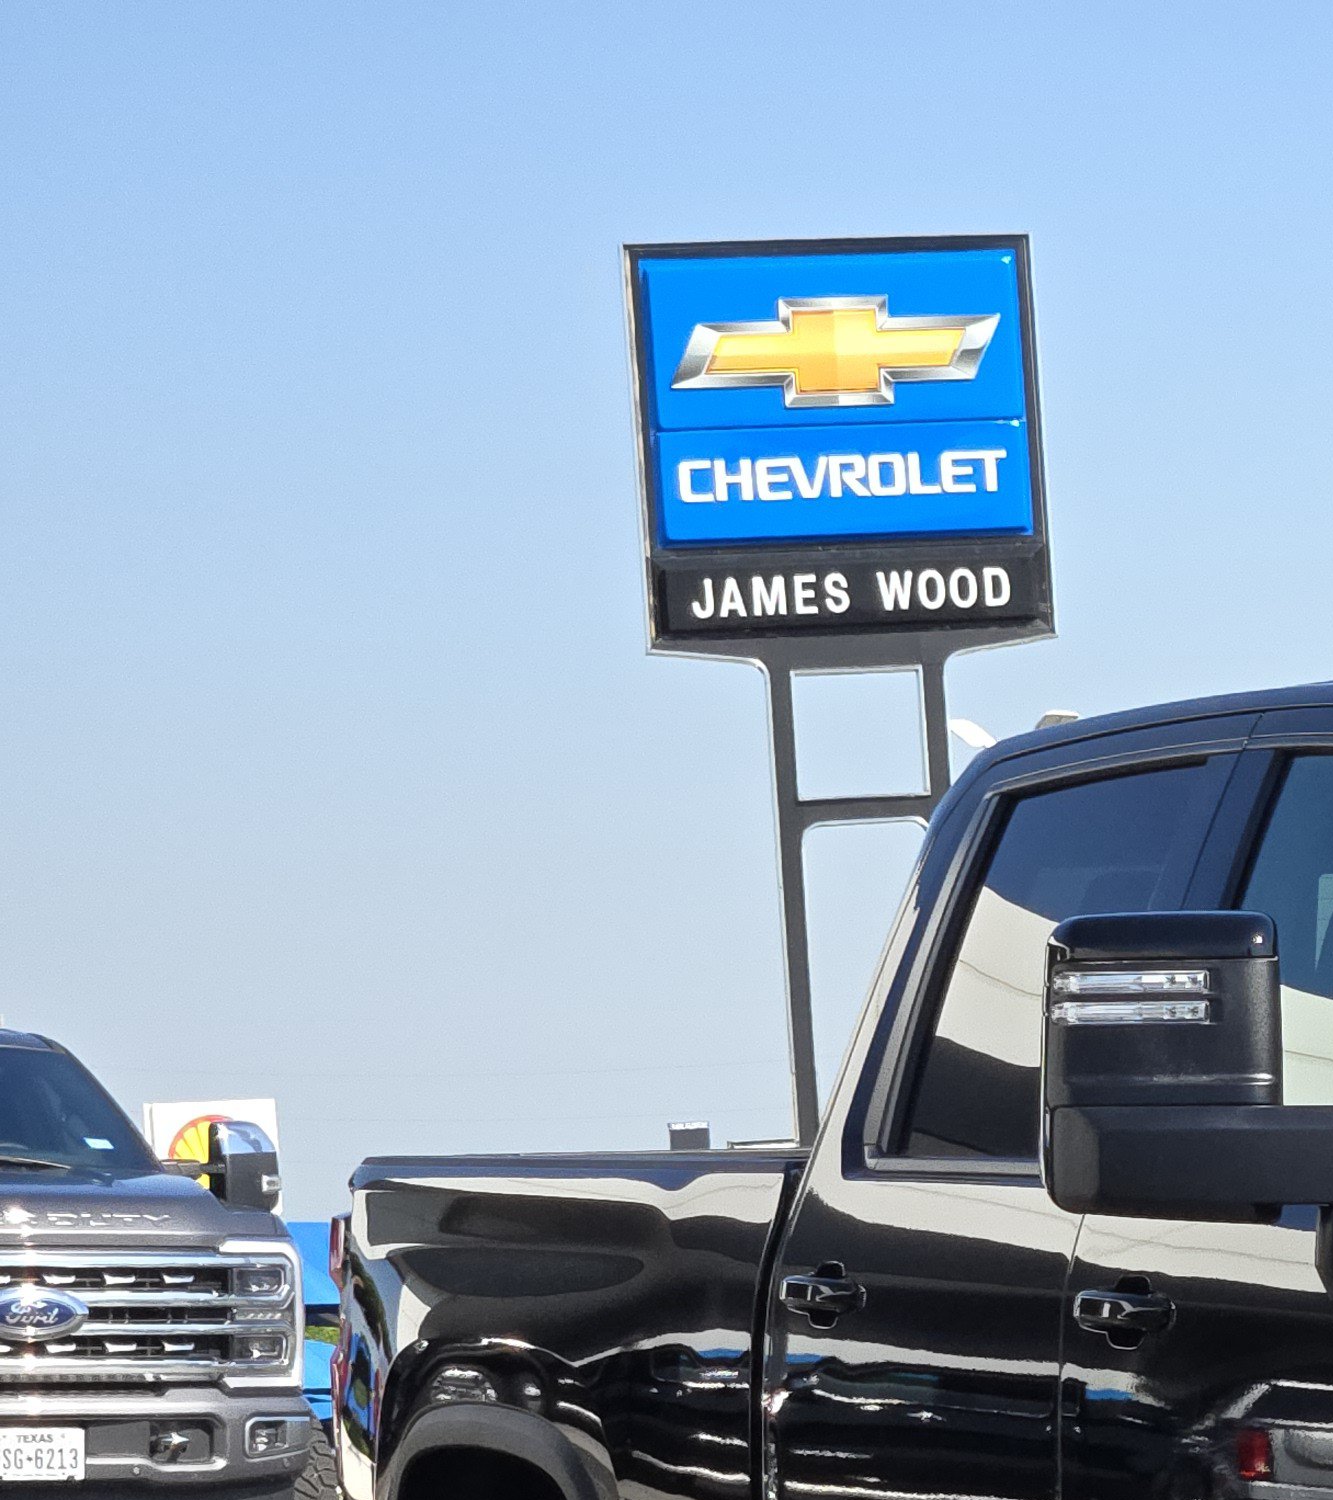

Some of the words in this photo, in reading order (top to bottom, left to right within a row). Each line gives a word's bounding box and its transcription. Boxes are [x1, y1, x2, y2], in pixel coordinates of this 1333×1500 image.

[677, 448, 1007, 503] CHEVROLET
[691, 571, 851, 619] JAMES
[876, 566, 1011, 612] WOOD
[16, 1434, 54, 1443] TEXAS
